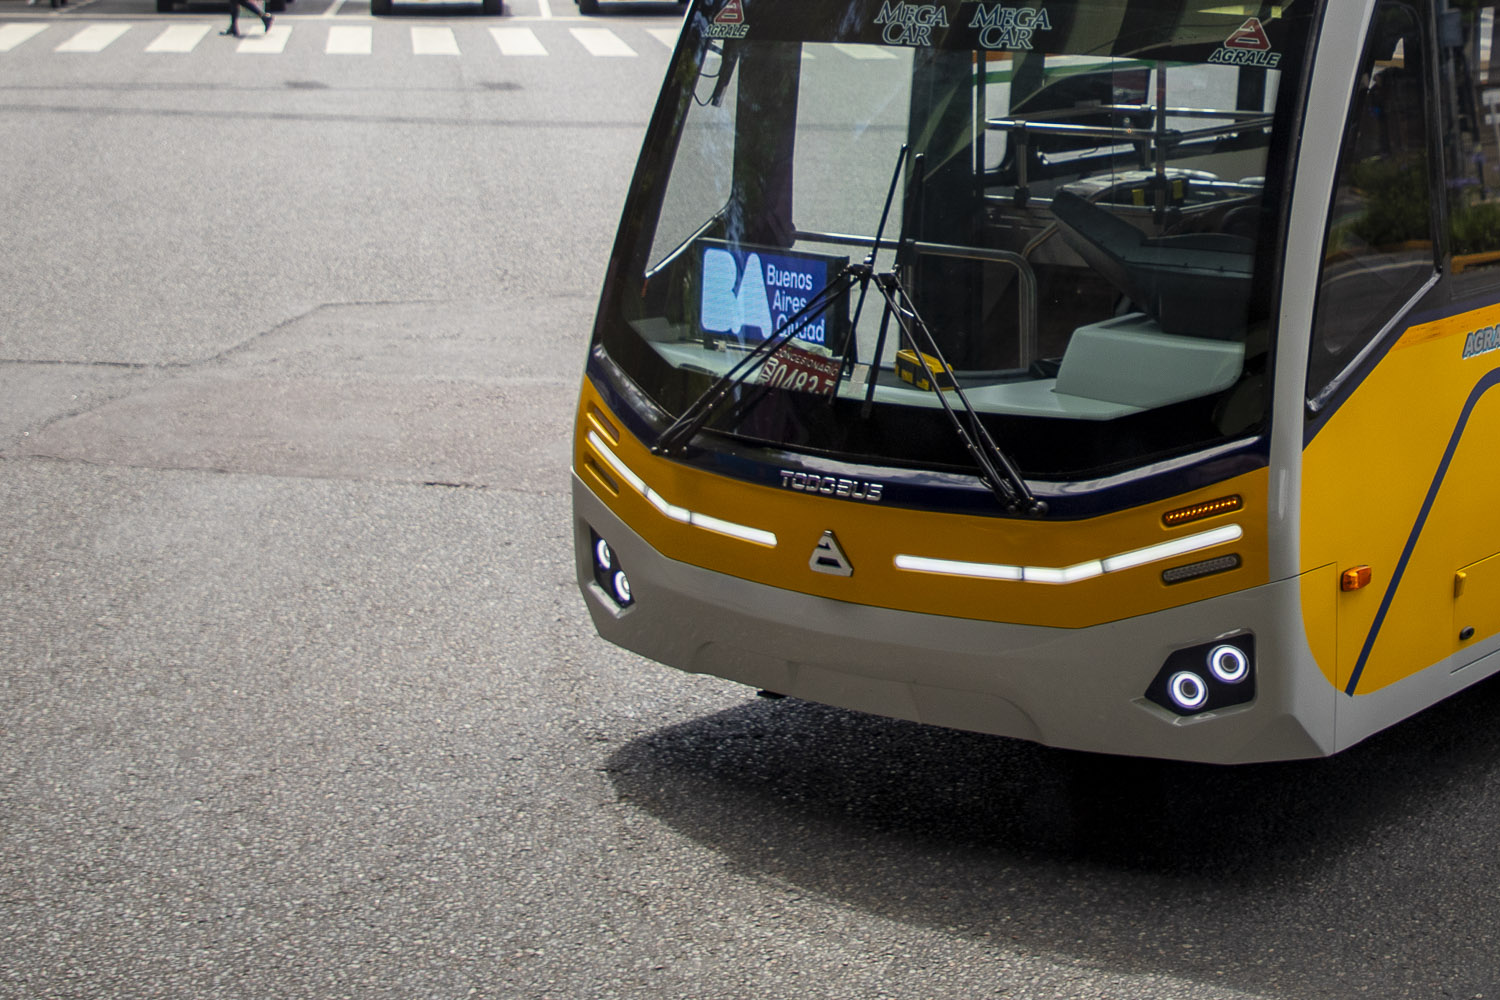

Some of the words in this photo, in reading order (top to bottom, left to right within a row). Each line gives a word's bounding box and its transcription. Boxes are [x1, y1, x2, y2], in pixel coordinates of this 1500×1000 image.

[874, 0, 949, 28] MEGA
[969, 2, 1052, 31] MEGA
[702, 24, 750, 39] AGRALE
[882, 23, 931, 46] CAR
[979, 25, 1033, 50] CAR
[1208, 48, 1282, 67] AGRALE
[767, 263, 813, 291] Buenos
[701, 248, 773, 340] BA
[772, 289, 807, 314] Aires
[781, 470, 884, 501] TODOBUS
